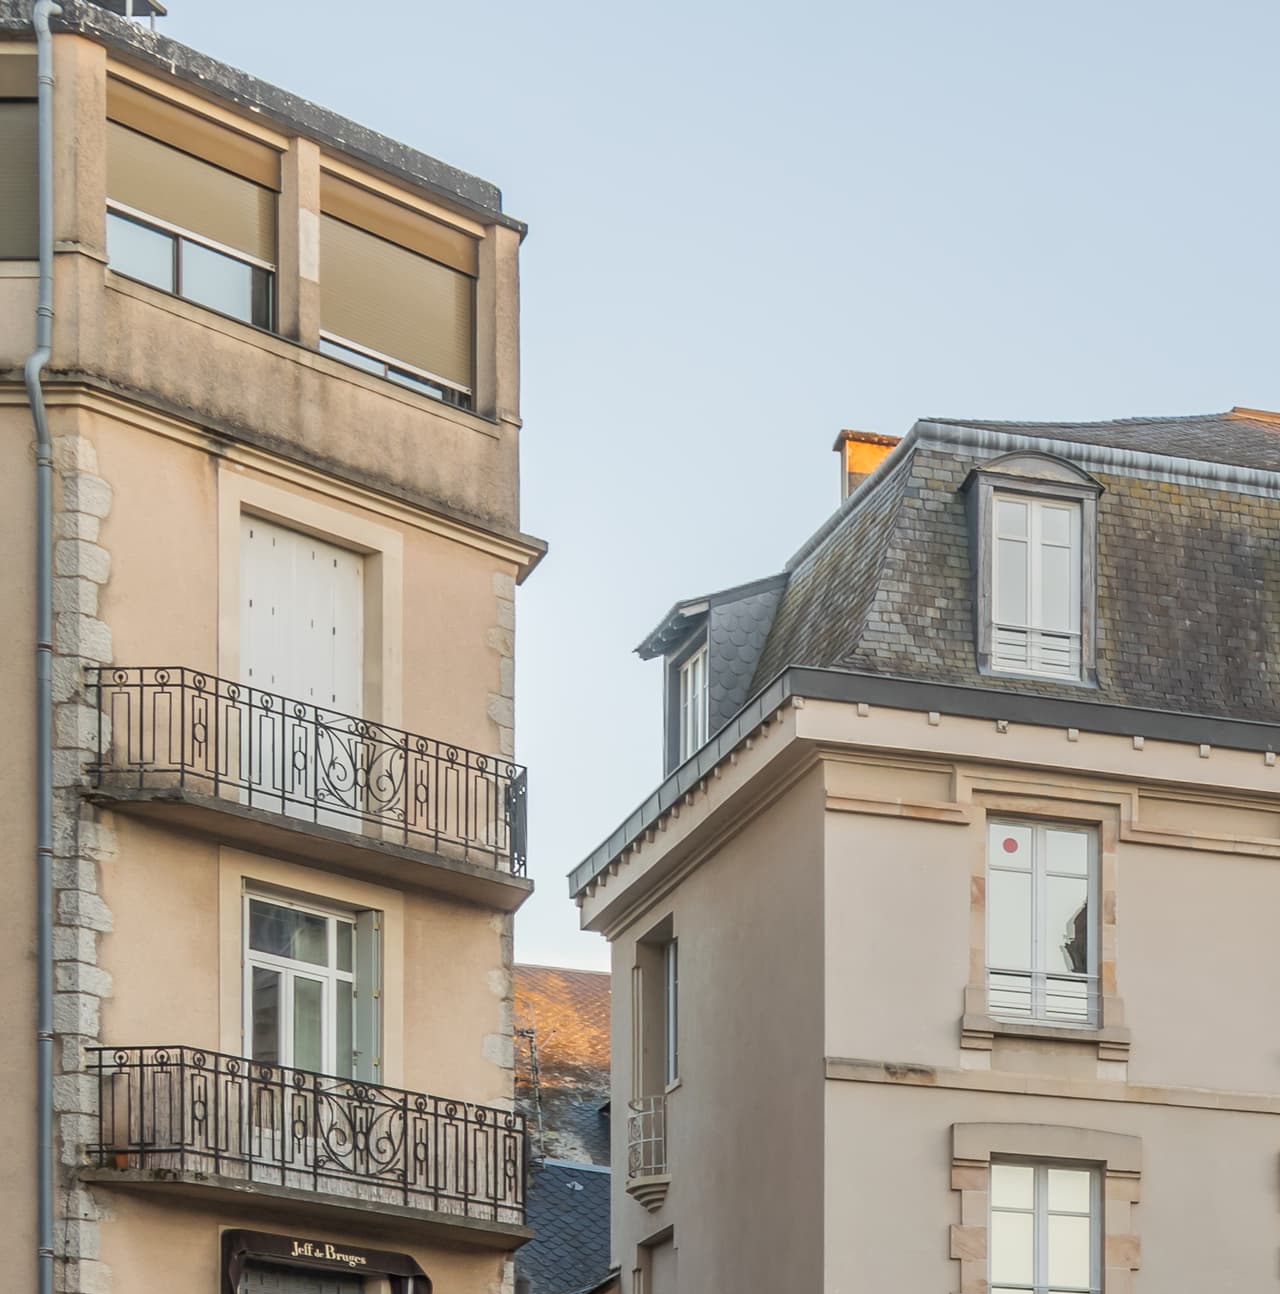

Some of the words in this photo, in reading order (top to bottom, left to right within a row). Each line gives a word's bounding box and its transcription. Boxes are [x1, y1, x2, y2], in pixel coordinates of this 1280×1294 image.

[291, 1241, 313, 1257] Jeff
[314, 1248, 324, 1258] de
[325, 1244, 367, 1267] Bruges
